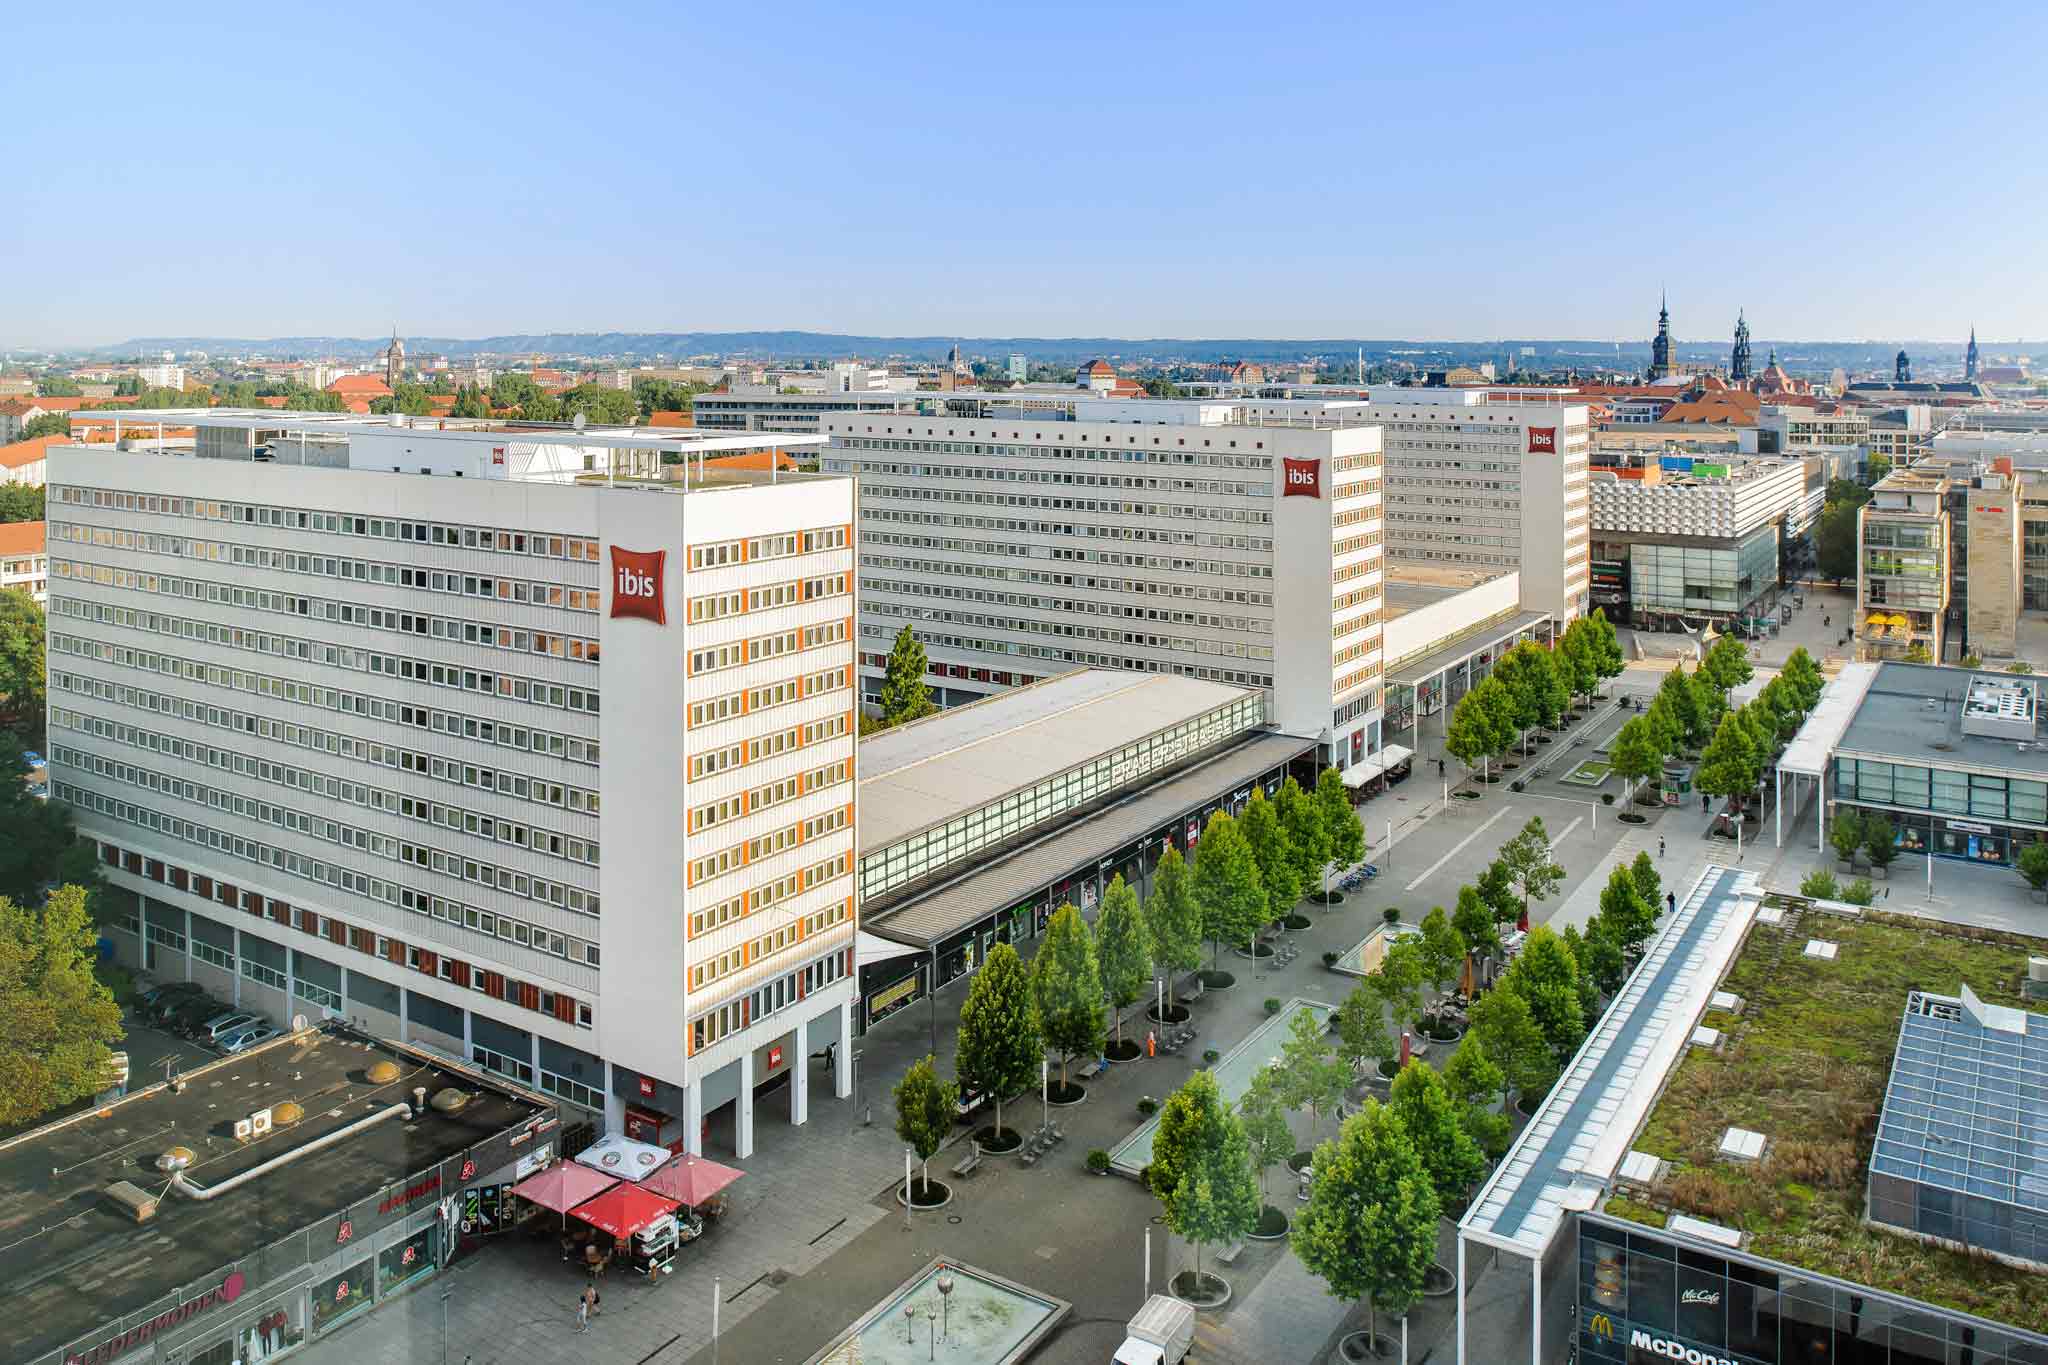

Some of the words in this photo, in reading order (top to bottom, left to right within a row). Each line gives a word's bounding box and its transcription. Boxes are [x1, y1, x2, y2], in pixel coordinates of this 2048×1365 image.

[1532, 432, 1552, 445] ibis
[1289, 468, 1315, 485] ibis
[618, 567, 655, 598] ibis
